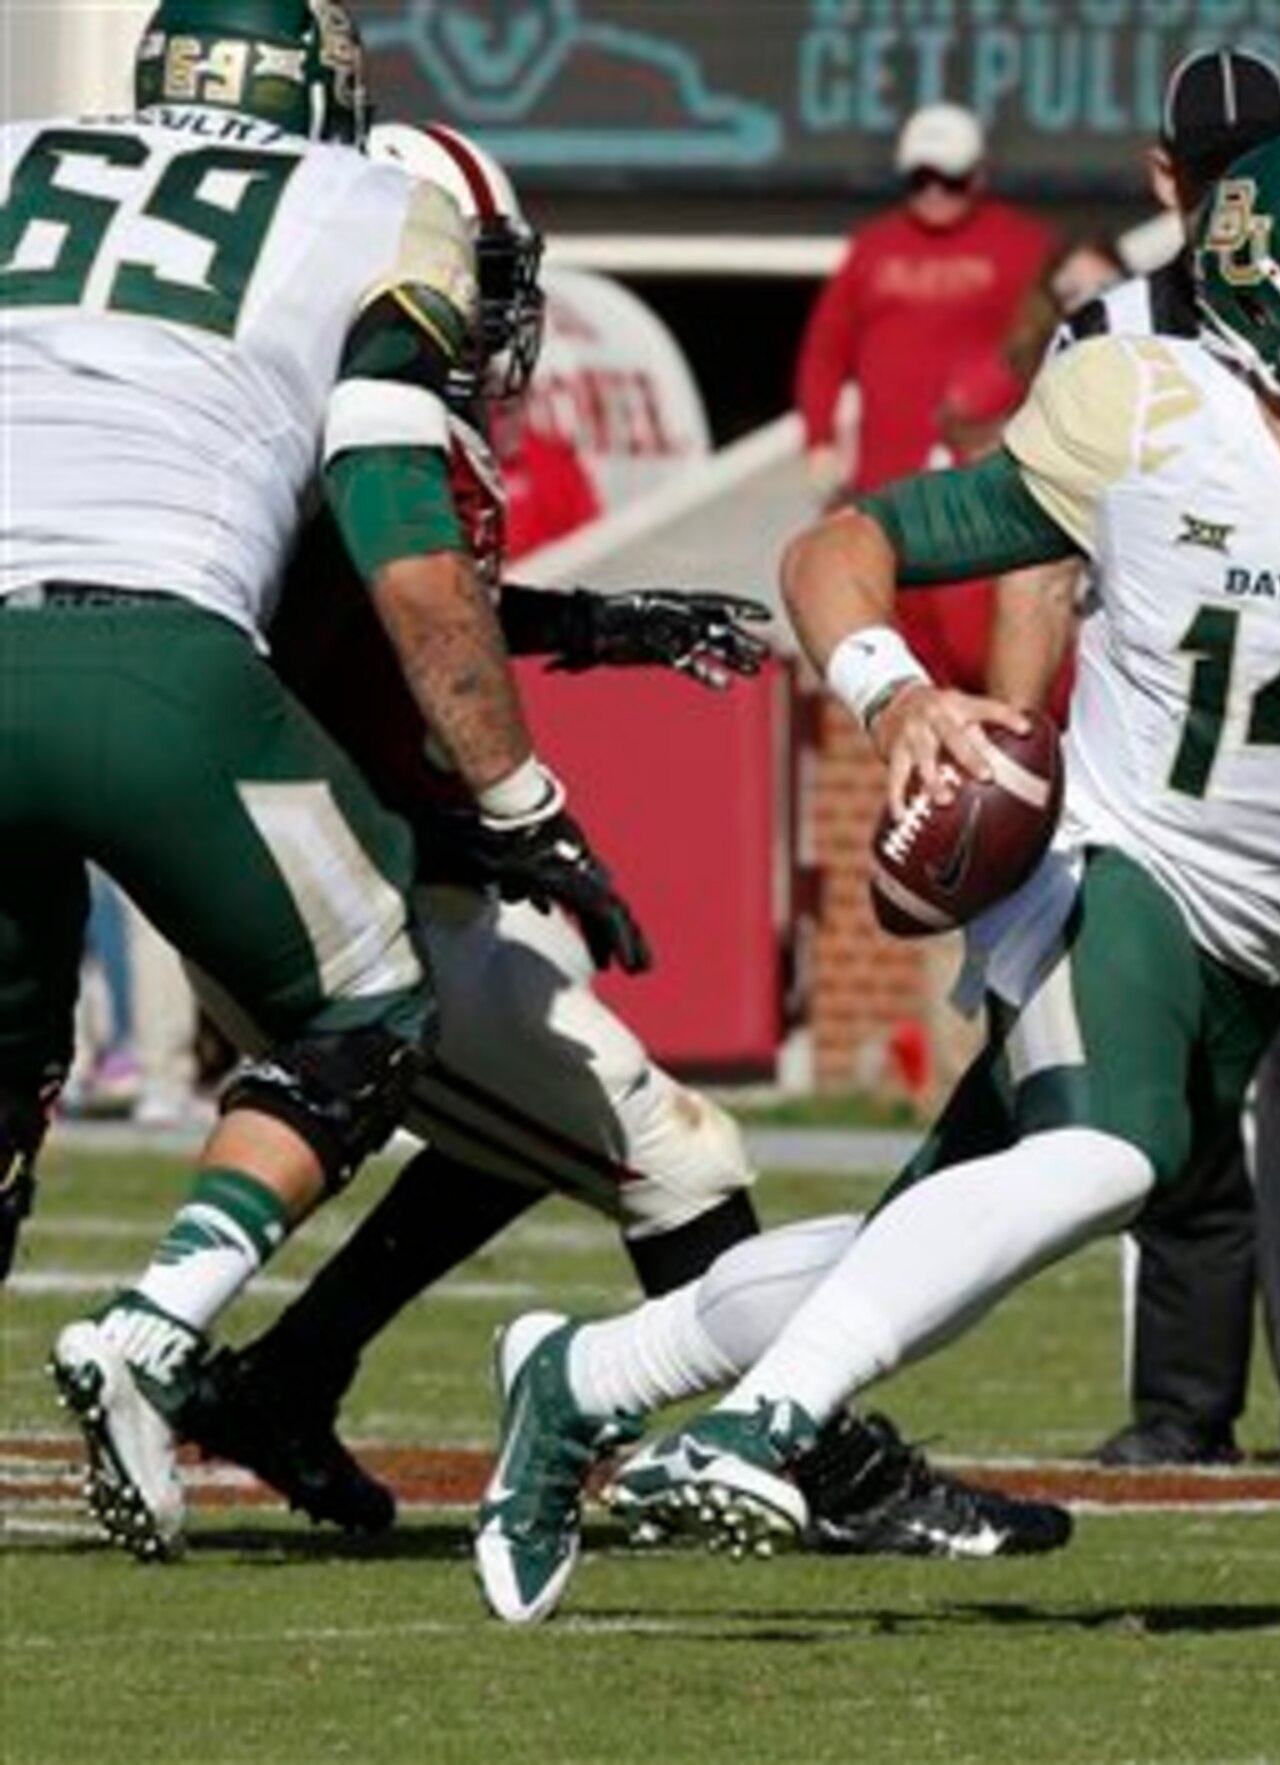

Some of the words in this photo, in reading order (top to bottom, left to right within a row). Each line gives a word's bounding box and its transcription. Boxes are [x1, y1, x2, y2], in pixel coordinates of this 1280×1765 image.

[163, 34, 251, 105] 69
[798, 27, 958, 131] GET
[0, 128, 304, 338] 69
[1205, 179, 1275, 285] BU
